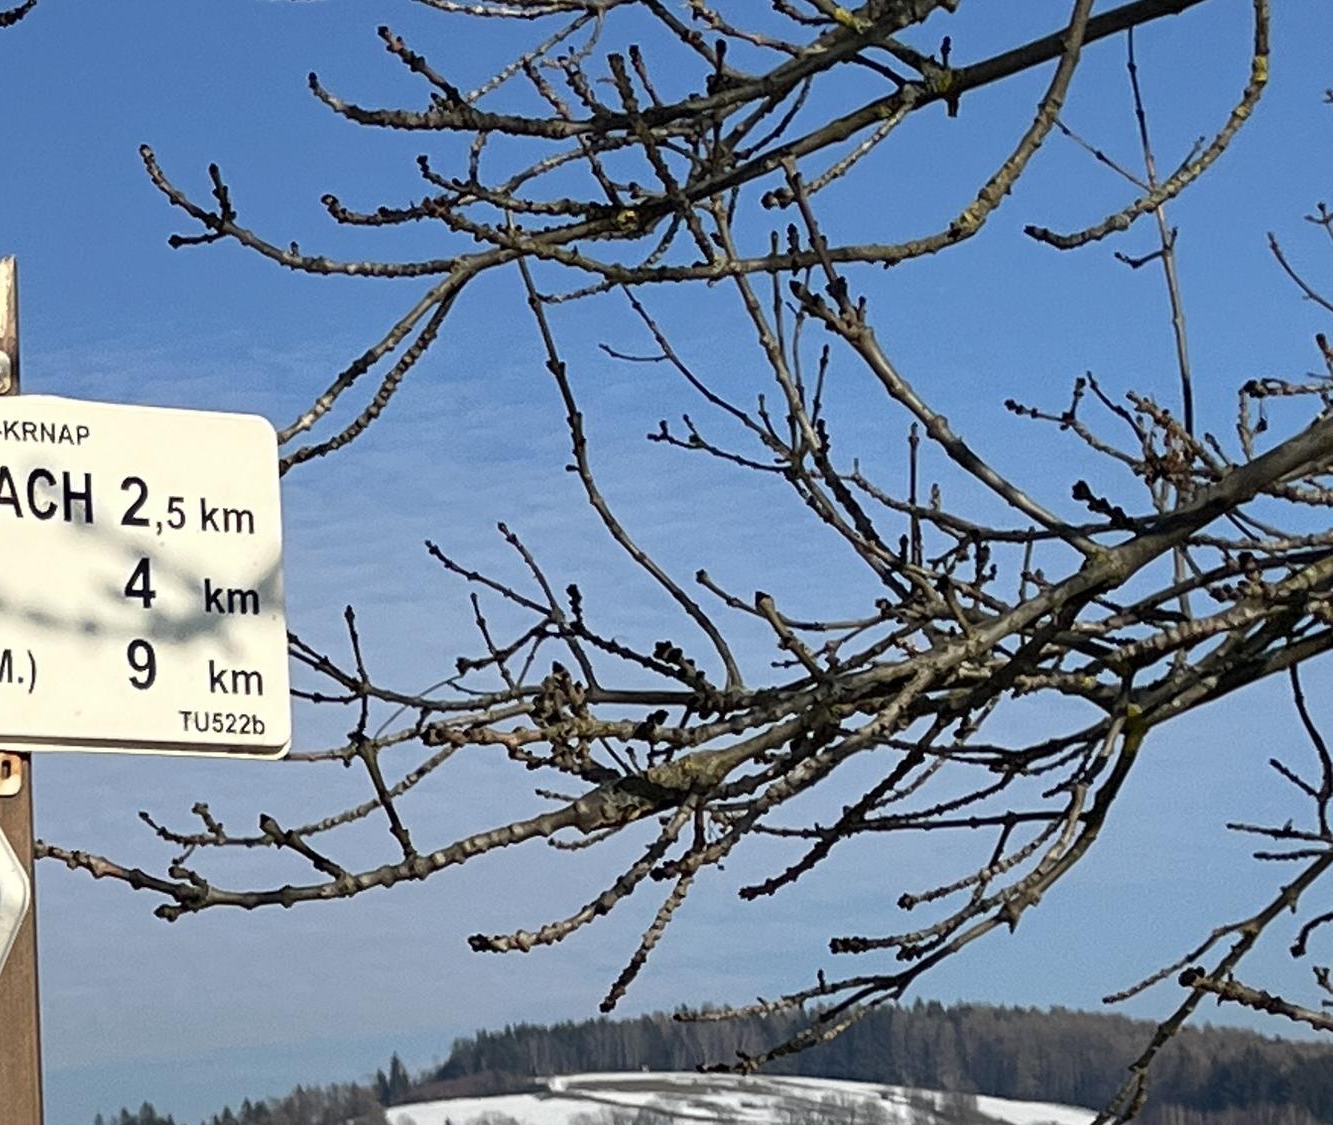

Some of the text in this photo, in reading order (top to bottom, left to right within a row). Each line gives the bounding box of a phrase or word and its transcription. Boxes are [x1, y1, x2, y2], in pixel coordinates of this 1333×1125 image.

[119, 477, 187, 536] 2,5
[201, 496, 256, 535] km
[125, 557, 157, 609] 4
[204, 578, 261, 615] km
[127, 638, 157, 690] 9
[210, 658, 264, 697] km
[179, 710, 266, 736] TU522b
